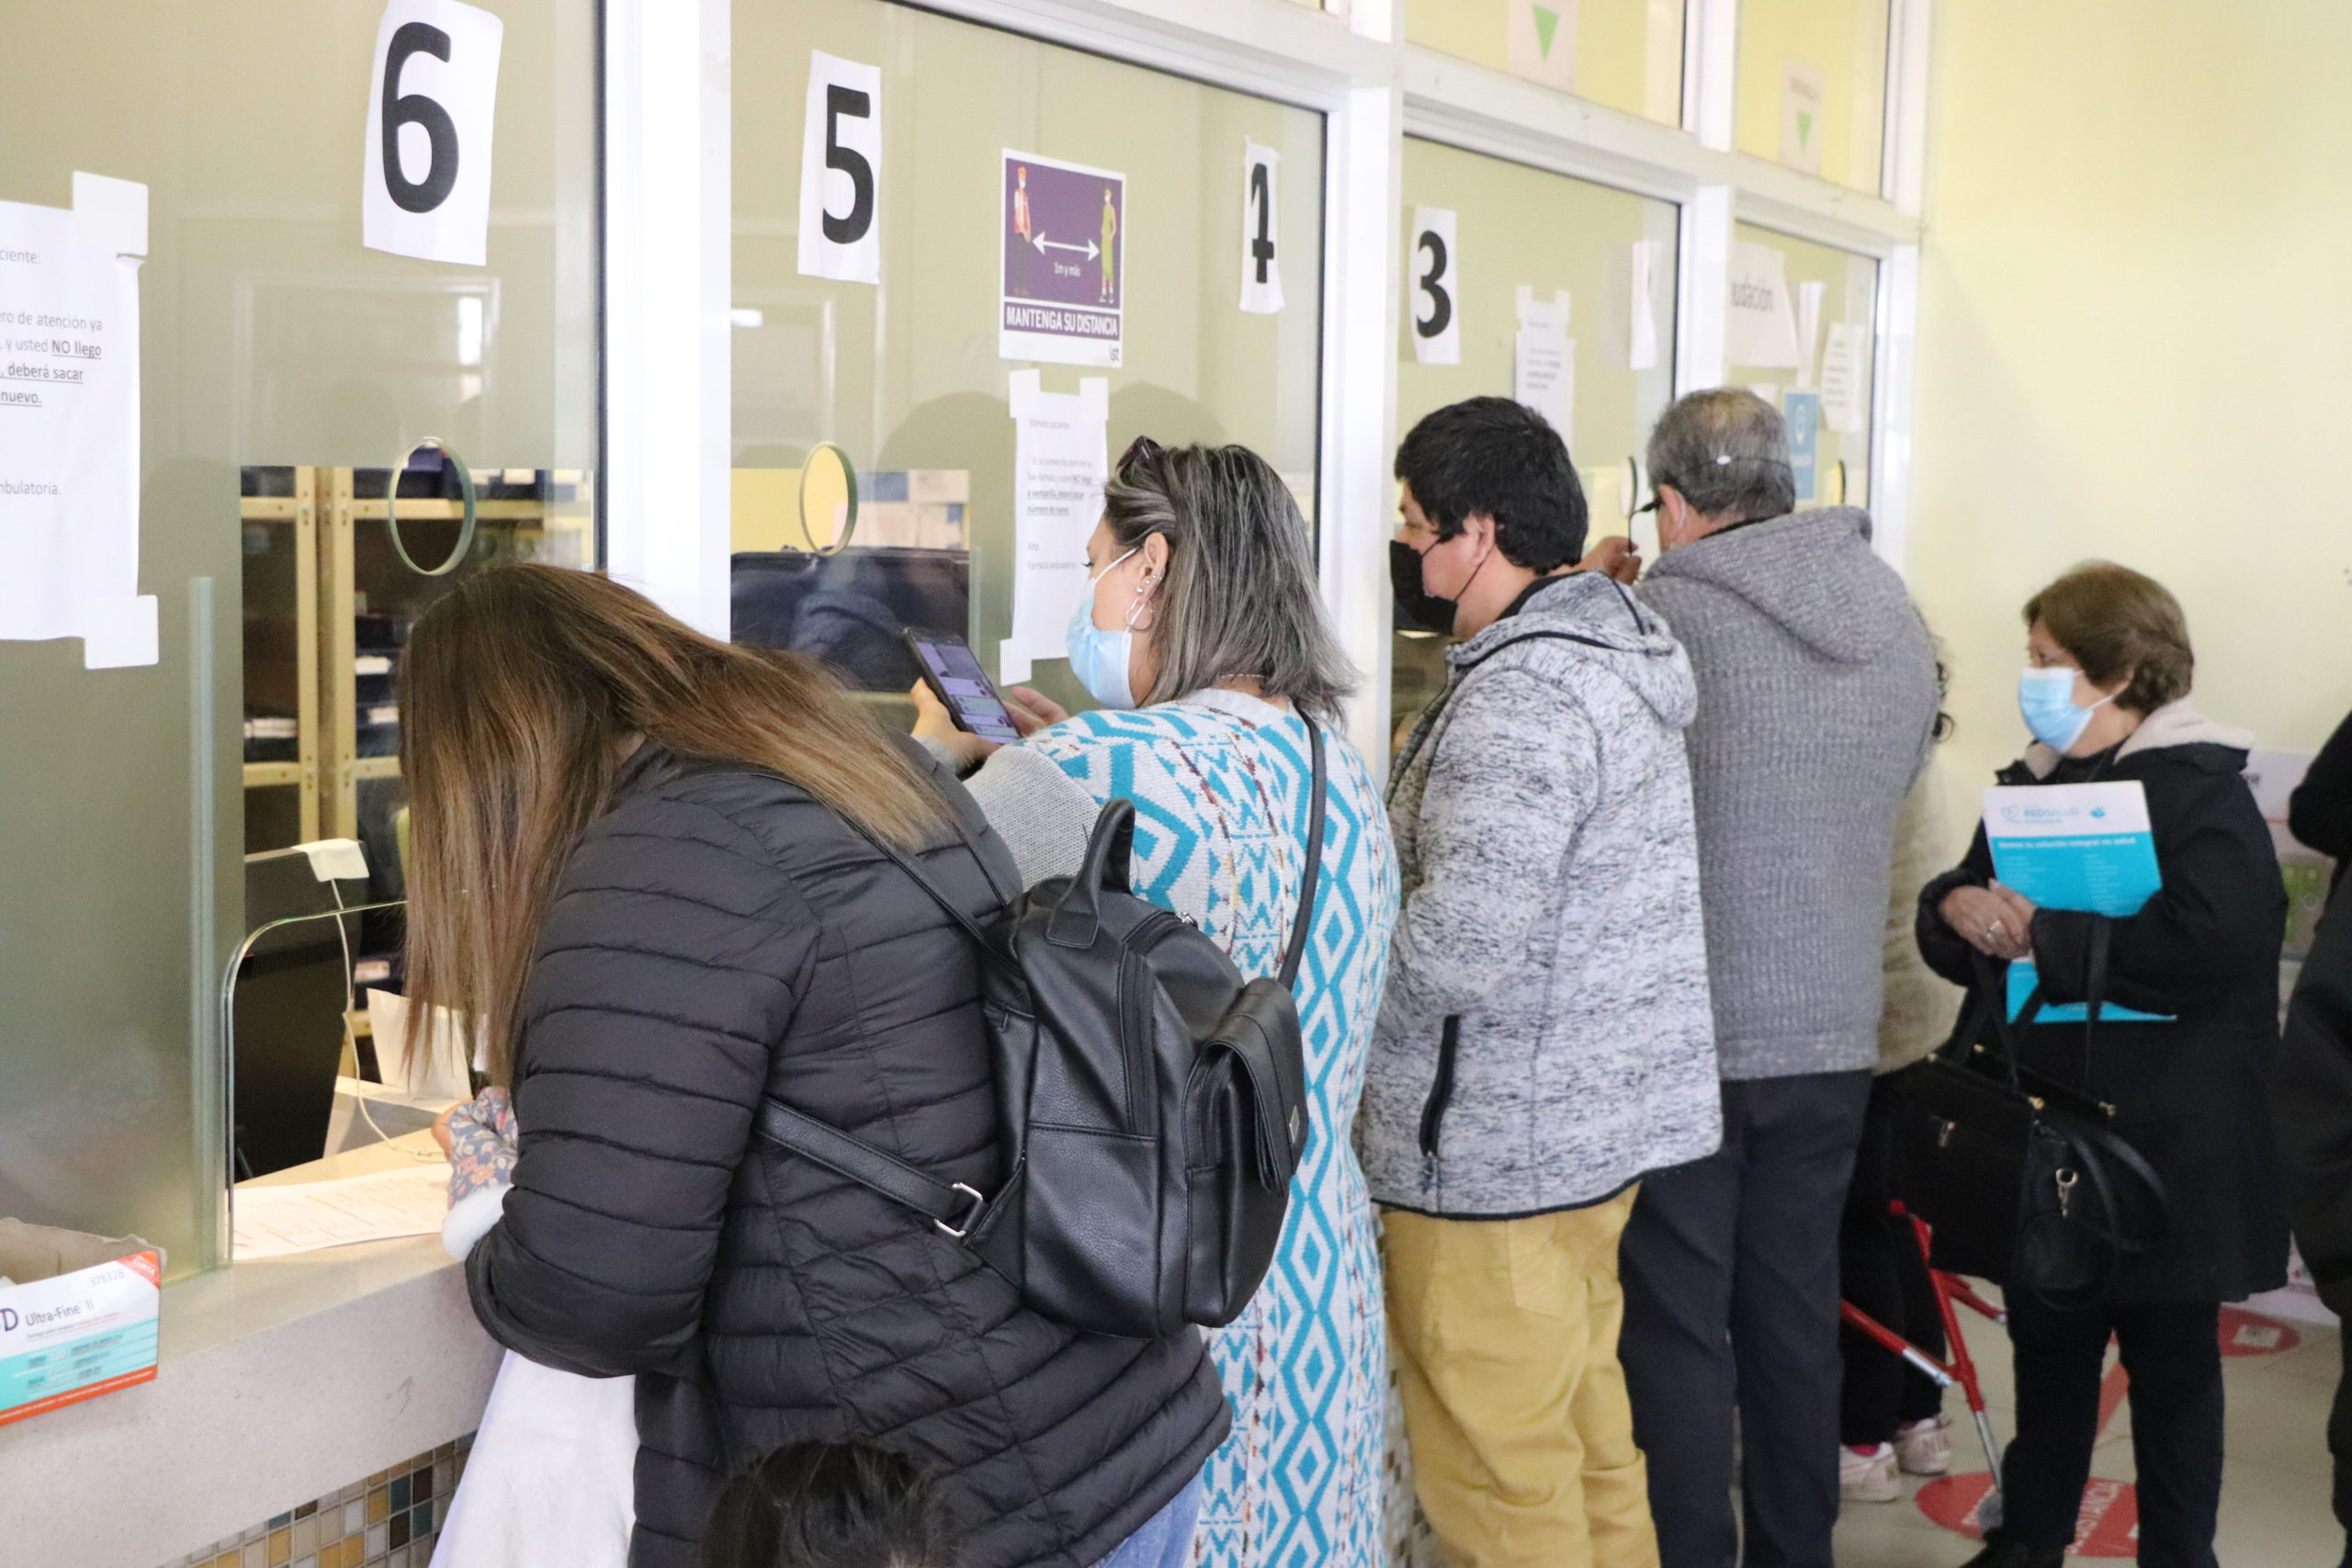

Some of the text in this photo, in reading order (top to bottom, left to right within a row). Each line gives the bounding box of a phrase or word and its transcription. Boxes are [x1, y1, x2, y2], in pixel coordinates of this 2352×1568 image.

[382, 21, 459, 213] 6
[822, 84, 874, 244] 5
[1416, 230, 1452, 339] 3
[17, 310, 33, 325] de
[37, 314, 87, 330] atención
[89, 320, 103, 333] ya
[1006, 306, 1119, 336] MANTENGA SU DISTANCIA
[16, 338, 49, 353] usted
[51, 340, 71, 355] NO
[74, 341, 102, 359] llego
[8, 362, 84, 381] deberá sacar
[0, 1307, 19, 1332] D
[25, 1304, 82, 1326] Ultra-Fine
